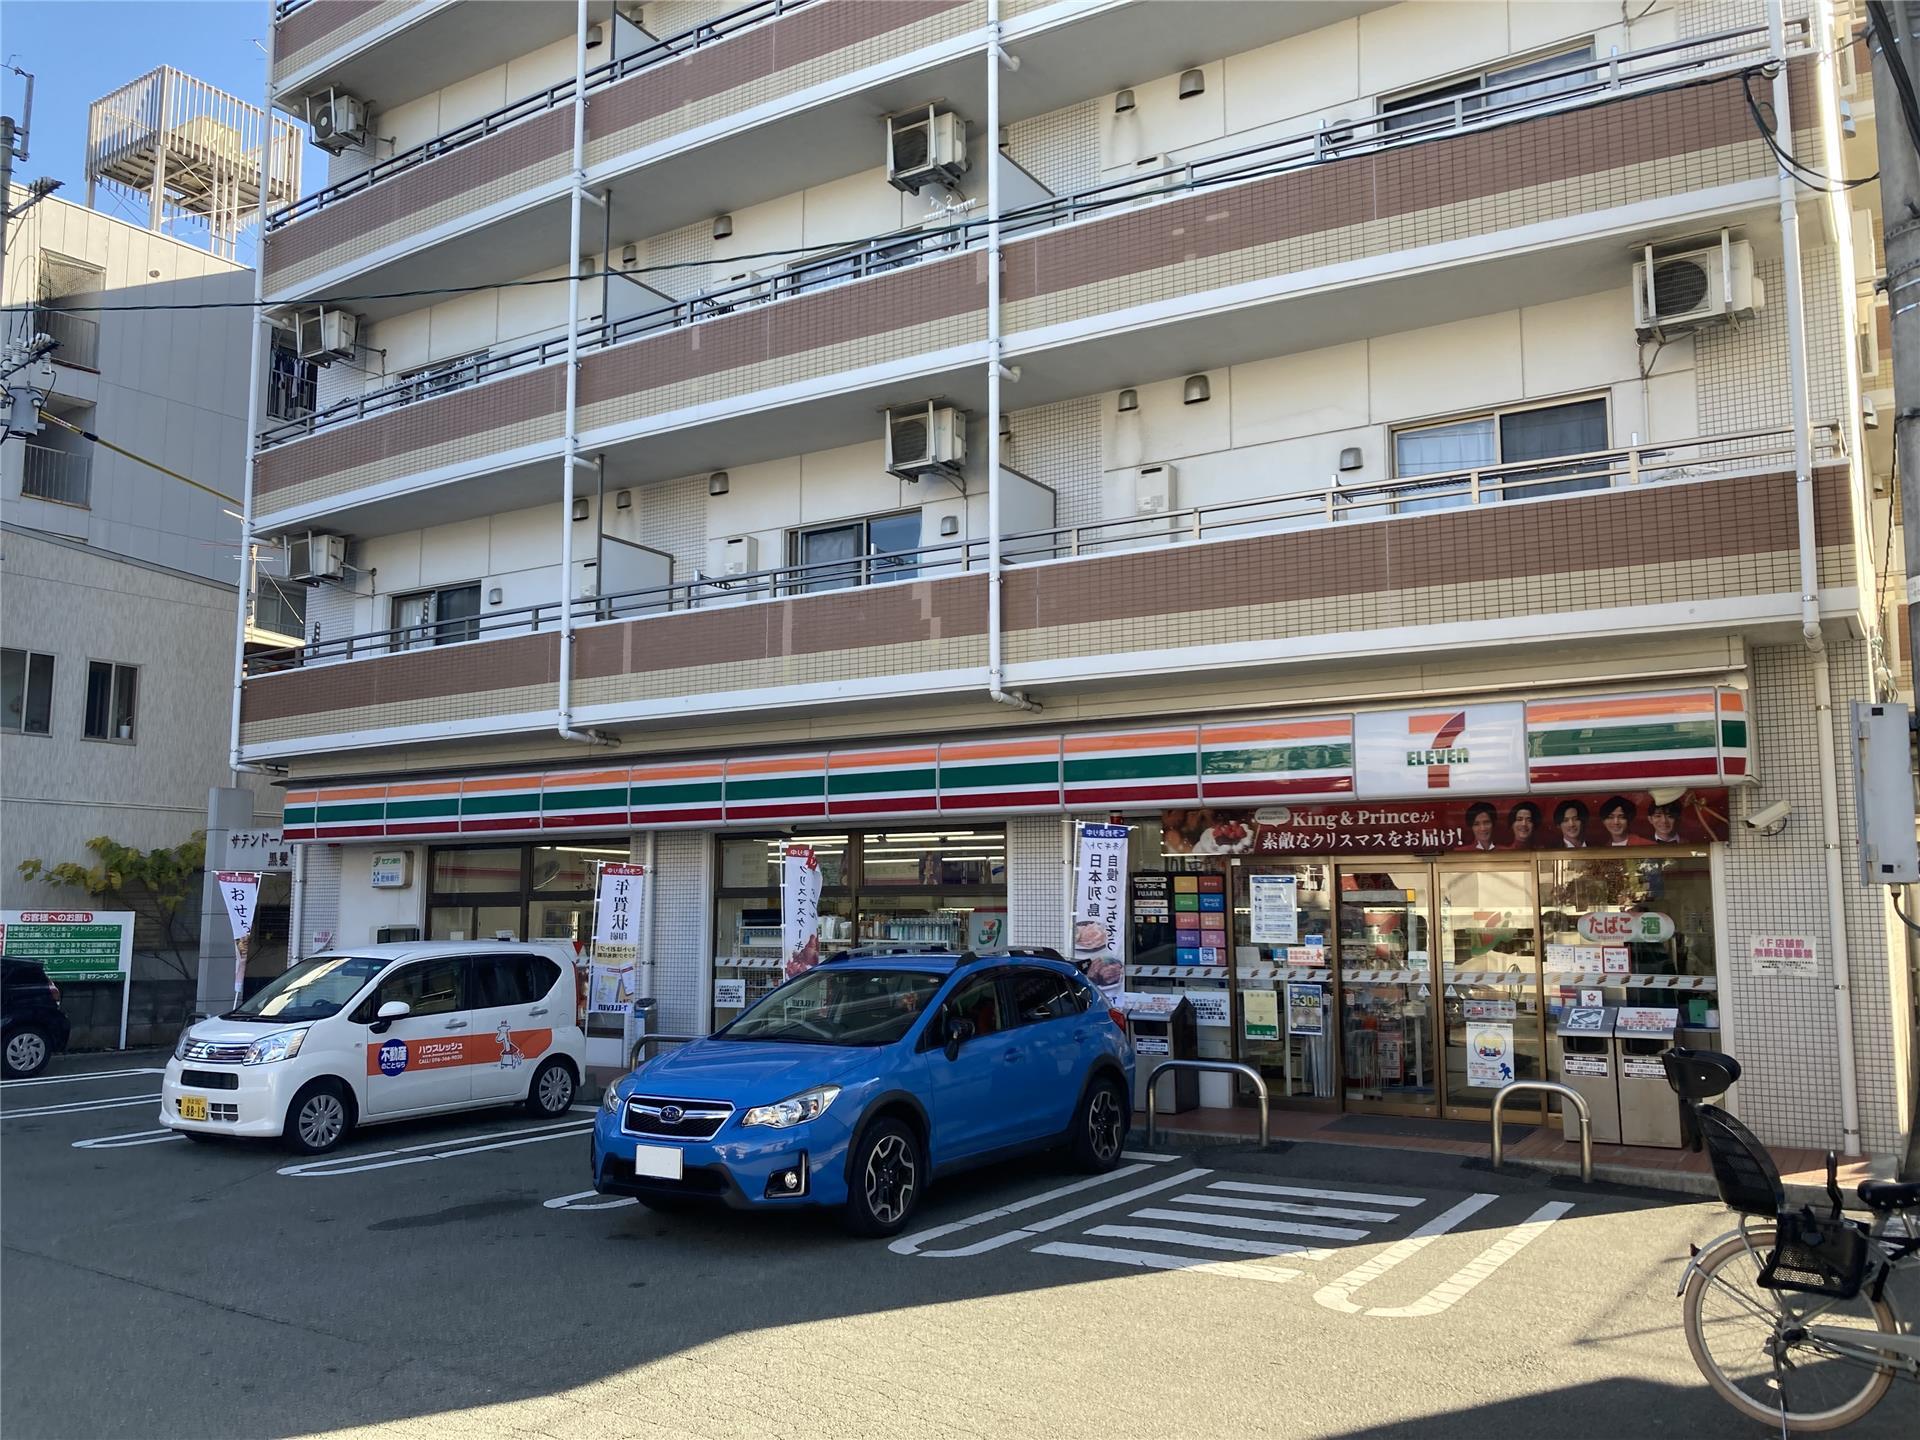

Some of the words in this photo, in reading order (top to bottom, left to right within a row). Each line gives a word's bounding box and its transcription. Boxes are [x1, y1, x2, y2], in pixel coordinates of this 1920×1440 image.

[1408, 711, 1465, 788] 7
[1292, 811, 1337, 829] King
[1340, 811, 1353, 826] &
[268, 851, 289, 866] 黒髪
[21, 912, 92, 922] お客様へのお願い
[1589, 916, 1632, 934] たばこ
[1641, 917, 1660, 934] 酒
[381, 1046, 407, 1062] 不動産
[418, 1042, 463, 1054] ハウスレッシュ
[381, 1062, 406, 1070] のことなら
